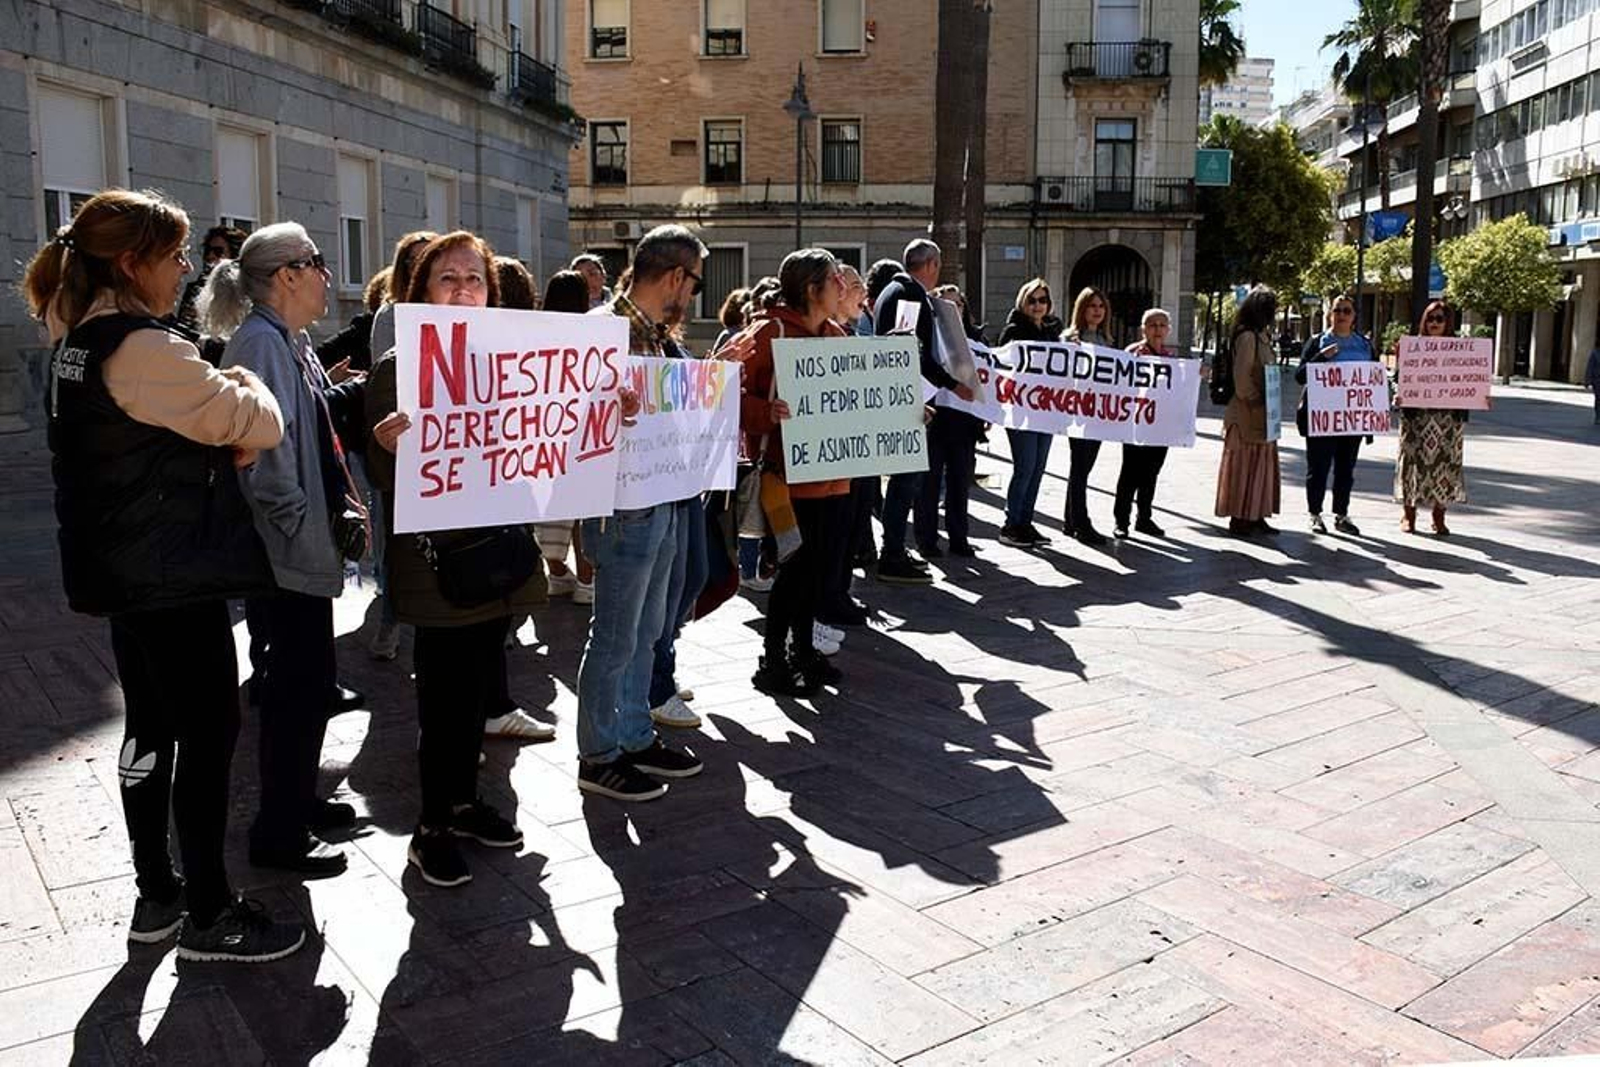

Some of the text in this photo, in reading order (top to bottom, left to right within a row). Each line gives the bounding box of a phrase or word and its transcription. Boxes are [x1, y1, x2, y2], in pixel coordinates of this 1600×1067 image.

[419, 322, 618, 409] NUESTROS
[795, 350, 910, 379] NOS QUITAN DINERO
[1350, 367, 1366, 386] AL
[796, 394, 814, 417] AL
[820, 387, 859, 413] PEDIR
[864, 386, 883, 409] LOS
[995, 374, 1027, 407] UN
[1097, 392, 1156, 425] JUSTO
[1347, 389, 1374, 408] POR
[1423, 389, 1432, 398] EL
[1449, 387, 1476, 398] GRADO
[420, 398, 579, 454] DERECHOS
[580, 399, 621, 451] NO
[1311, 410, 1329, 432] NO
[791, 429, 921, 466] DE ASUNTOS PROPIOS
[420, 457, 464, 498] SE
[482, 441, 568, 487] TOCAN
